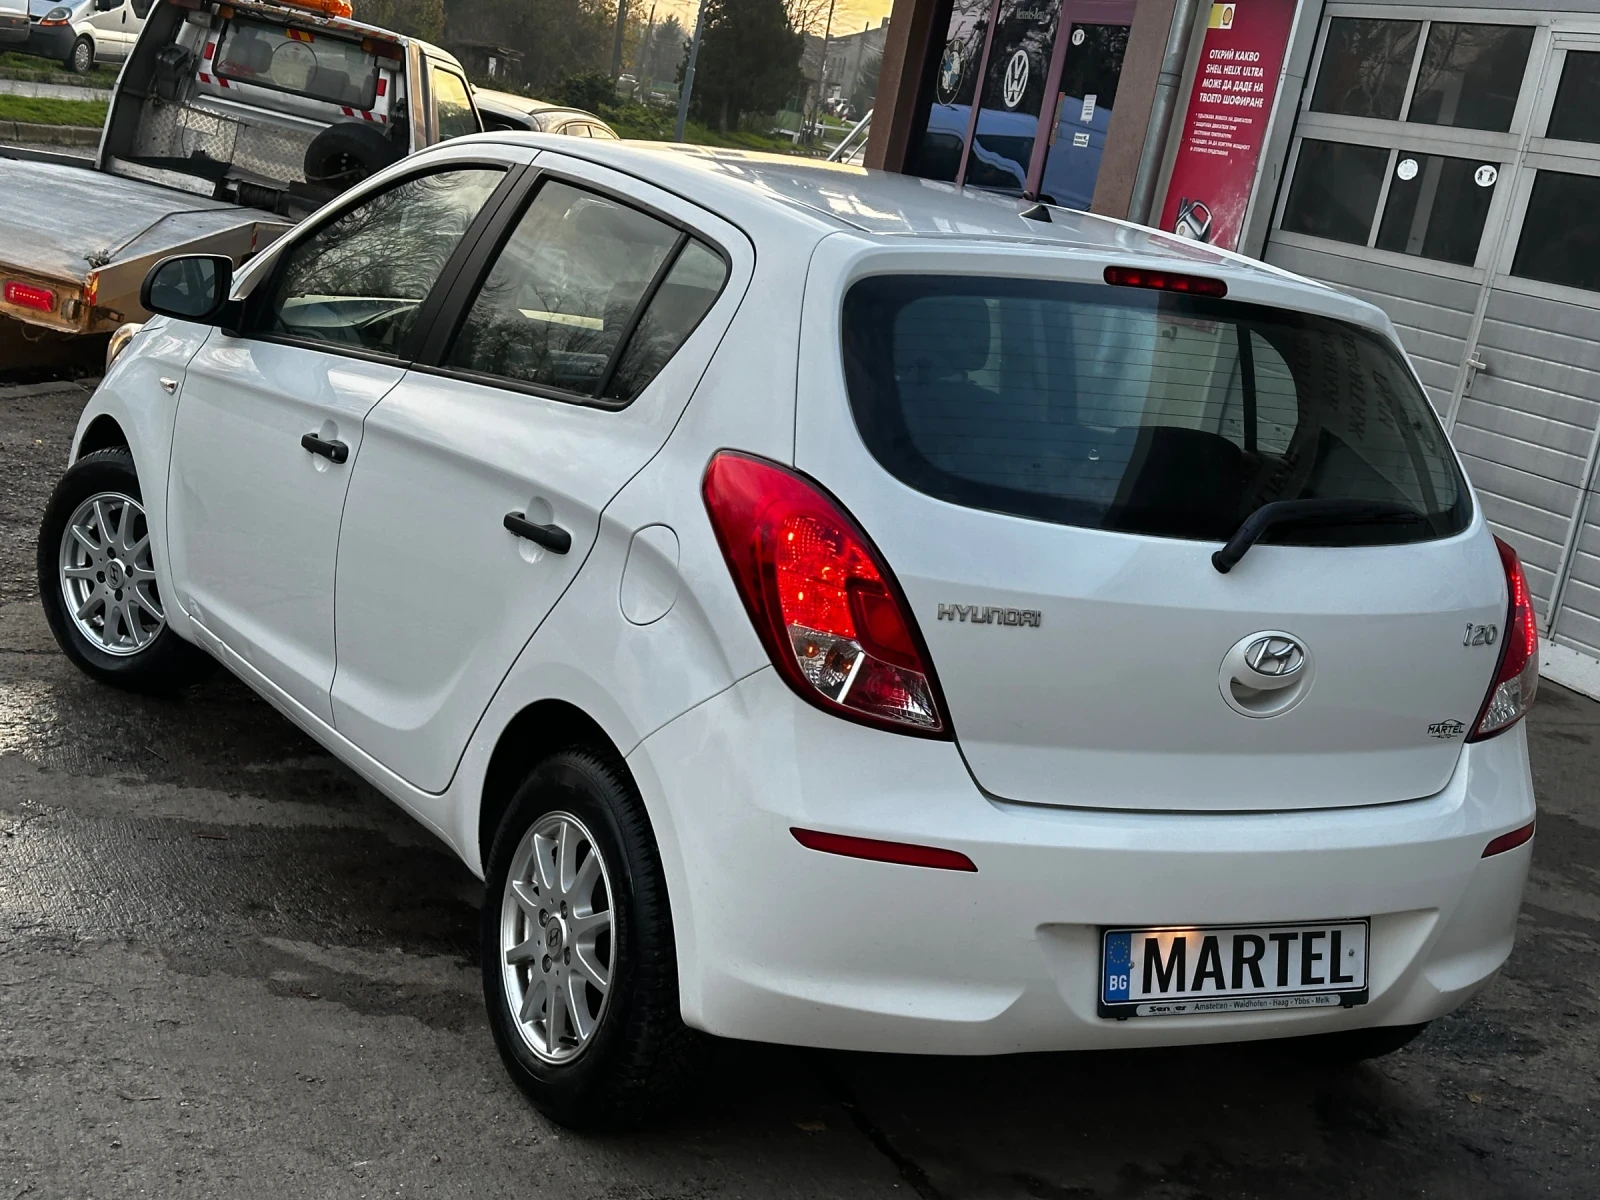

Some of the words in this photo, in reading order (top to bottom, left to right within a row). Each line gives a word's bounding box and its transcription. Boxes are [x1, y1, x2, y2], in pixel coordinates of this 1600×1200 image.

[1209, 48, 1235, 60] ОТКРИЙ
[1235, 51, 1260, 62] КАКВО
[1205, 64, 1222, 74] SHELL
[1223, 65, 1242, 76] HELIX
[1242, 66, 1264, 77] ULTRA
[1201, 78, 1222, 89] МОЖЕ
[1222, 80, 1232, 91] ДА
[1232, 81, 1252, 93] ДАДЕ
[1253, 82, 1264, 93] НА
[1199, 92, 1222, 103] ТВОЕТО
[1222, 95, 1264, 108] ШОФИРАНЕ
[937, 603, 1042, 628] HYUNDAI
[1463, 622, 1498, 647] i20
[1427, 724, 1464, 734] MARTEL
[1109, 975, 1127, 991] BG
[1142, 930, 1354, 994] MARTEL
[1233, 999, 1268, 1008] Waidhofen
[1273, 999, 1289, 1007] Haag
